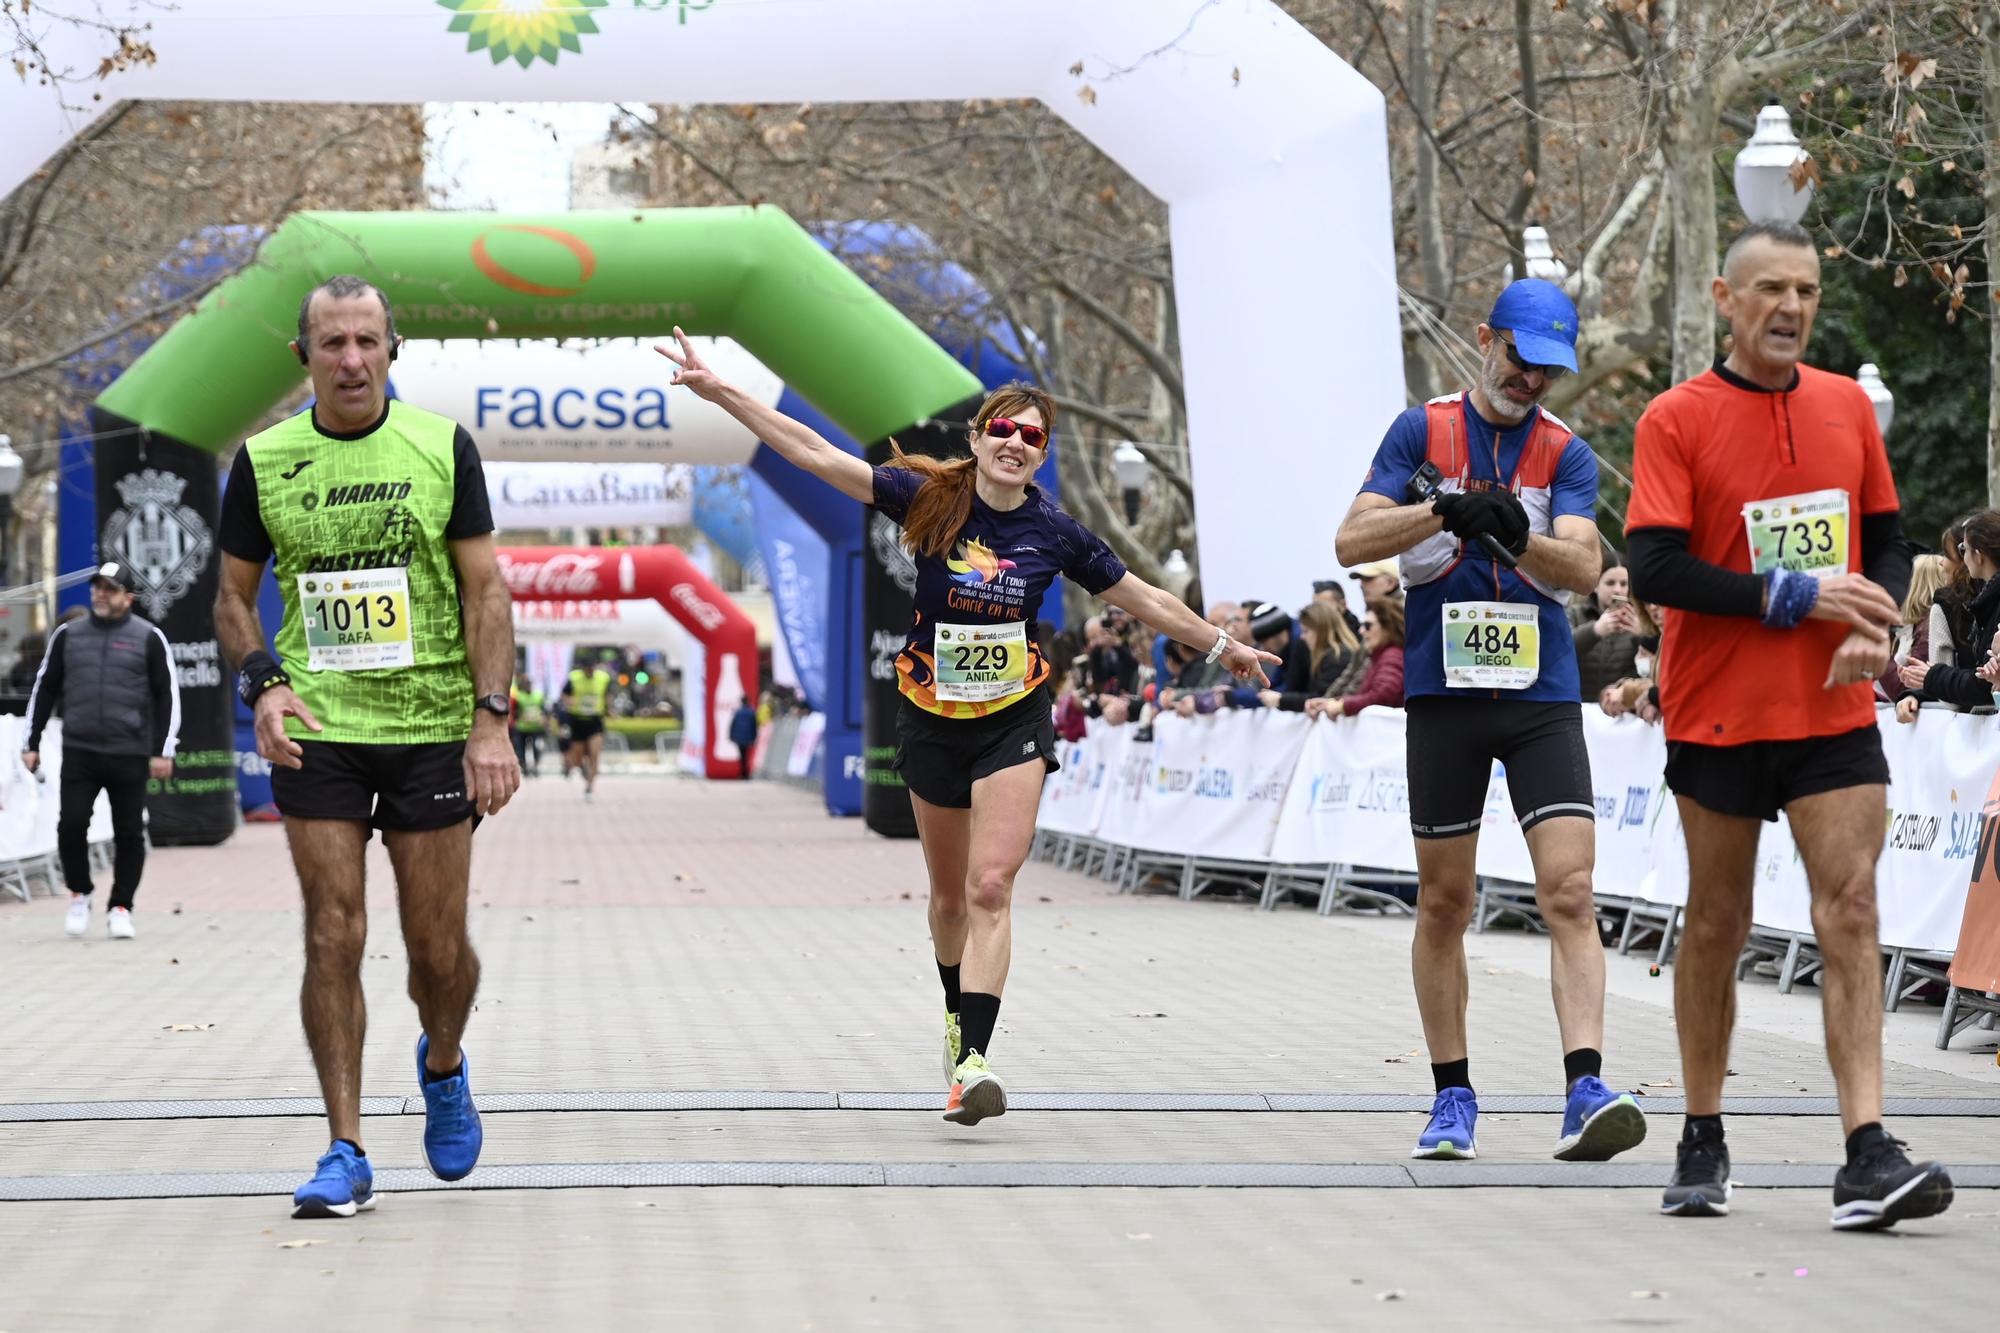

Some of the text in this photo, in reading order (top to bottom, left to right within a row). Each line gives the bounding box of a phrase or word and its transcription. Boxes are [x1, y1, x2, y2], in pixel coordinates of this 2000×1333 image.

[393, 302, 697, 321] ATRONAT D'ESPORTS
[323, 476, 413, 508] MARATÓ
[1770, 518, 1832, 559] 733
[1777, 552, 1837, 571] AVI SANZ
[315, 595, 396, 632] 1013
[988, 603, 1003, 617] en
[338, 631, 373, 645] RAFA
[1464, 624, 1520, 654] 484
[954, 644, 1009, 671] 229
[1475, 655, 1511, 666] DIEGO
[965, 671, 999, 682] ANITA
